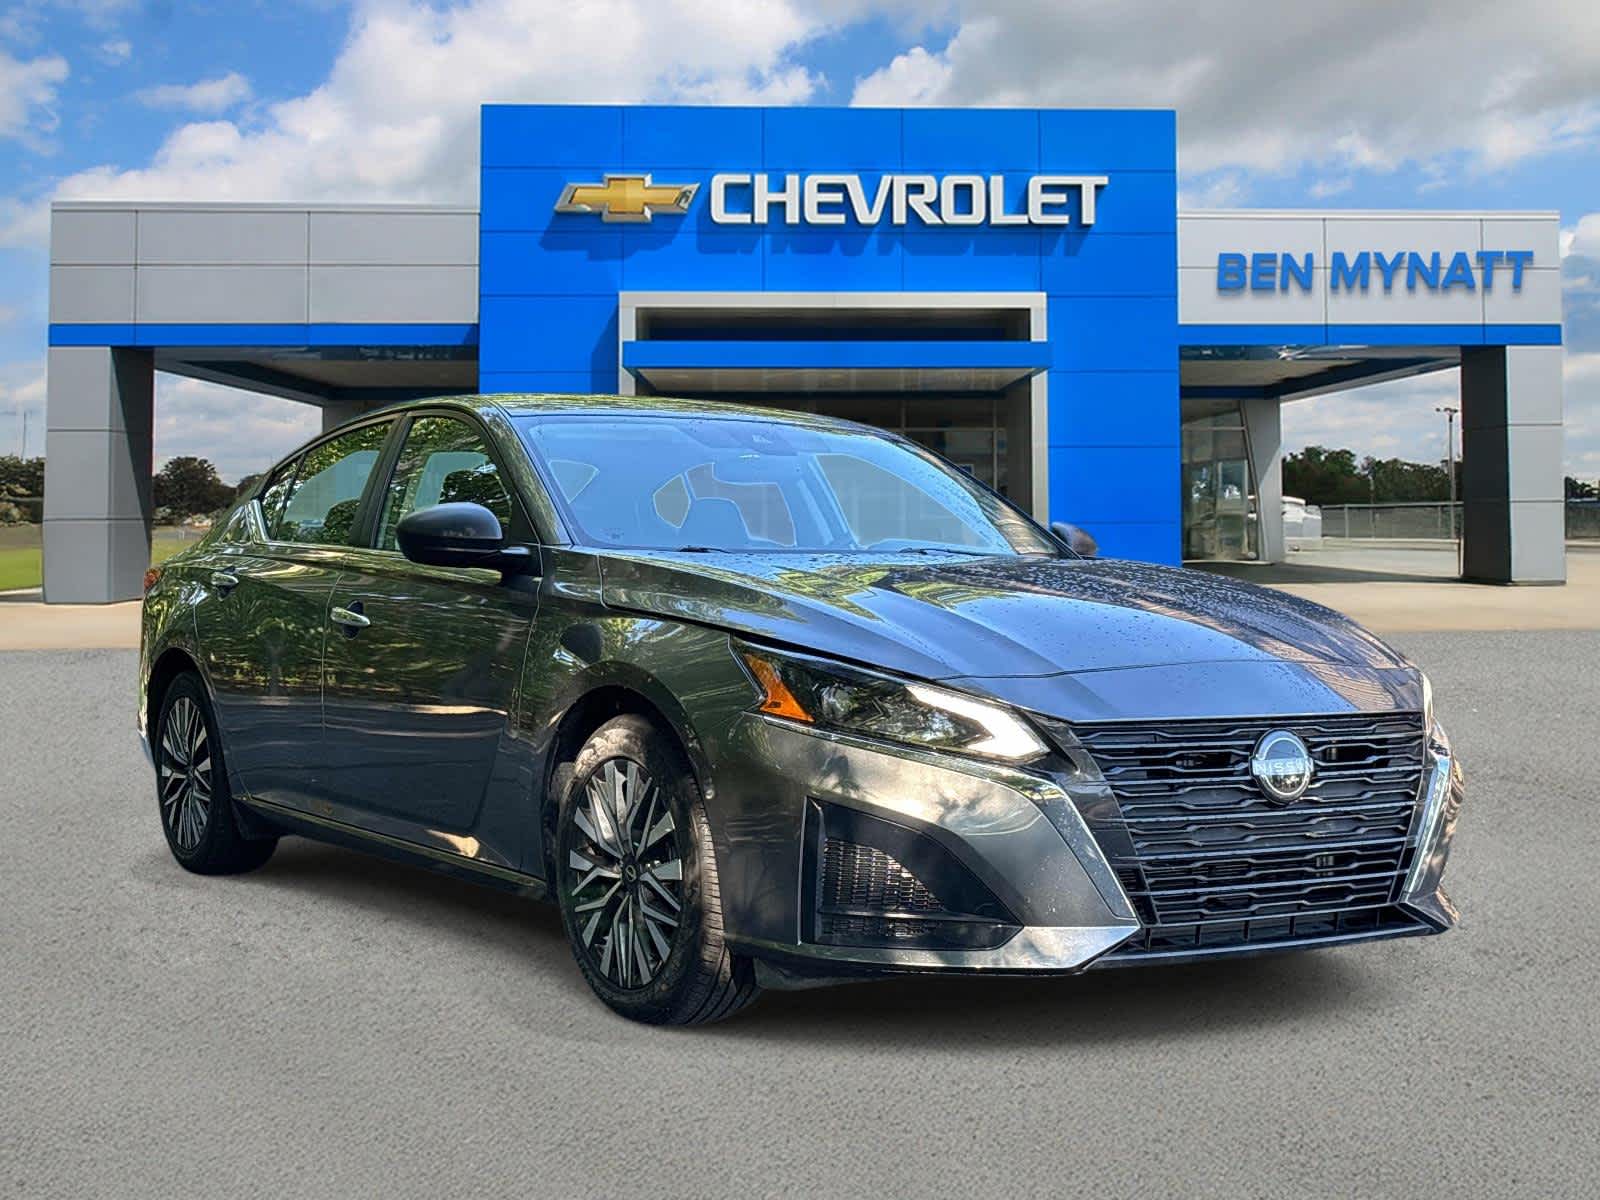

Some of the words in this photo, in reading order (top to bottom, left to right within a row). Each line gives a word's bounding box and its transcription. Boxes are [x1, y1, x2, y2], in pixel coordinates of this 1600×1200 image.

[710, 173, 1109, 225] CHEVROLET
[1217, 252, 1314, 290] BEN
[1330, 251, 1534, 290] MYNATT
